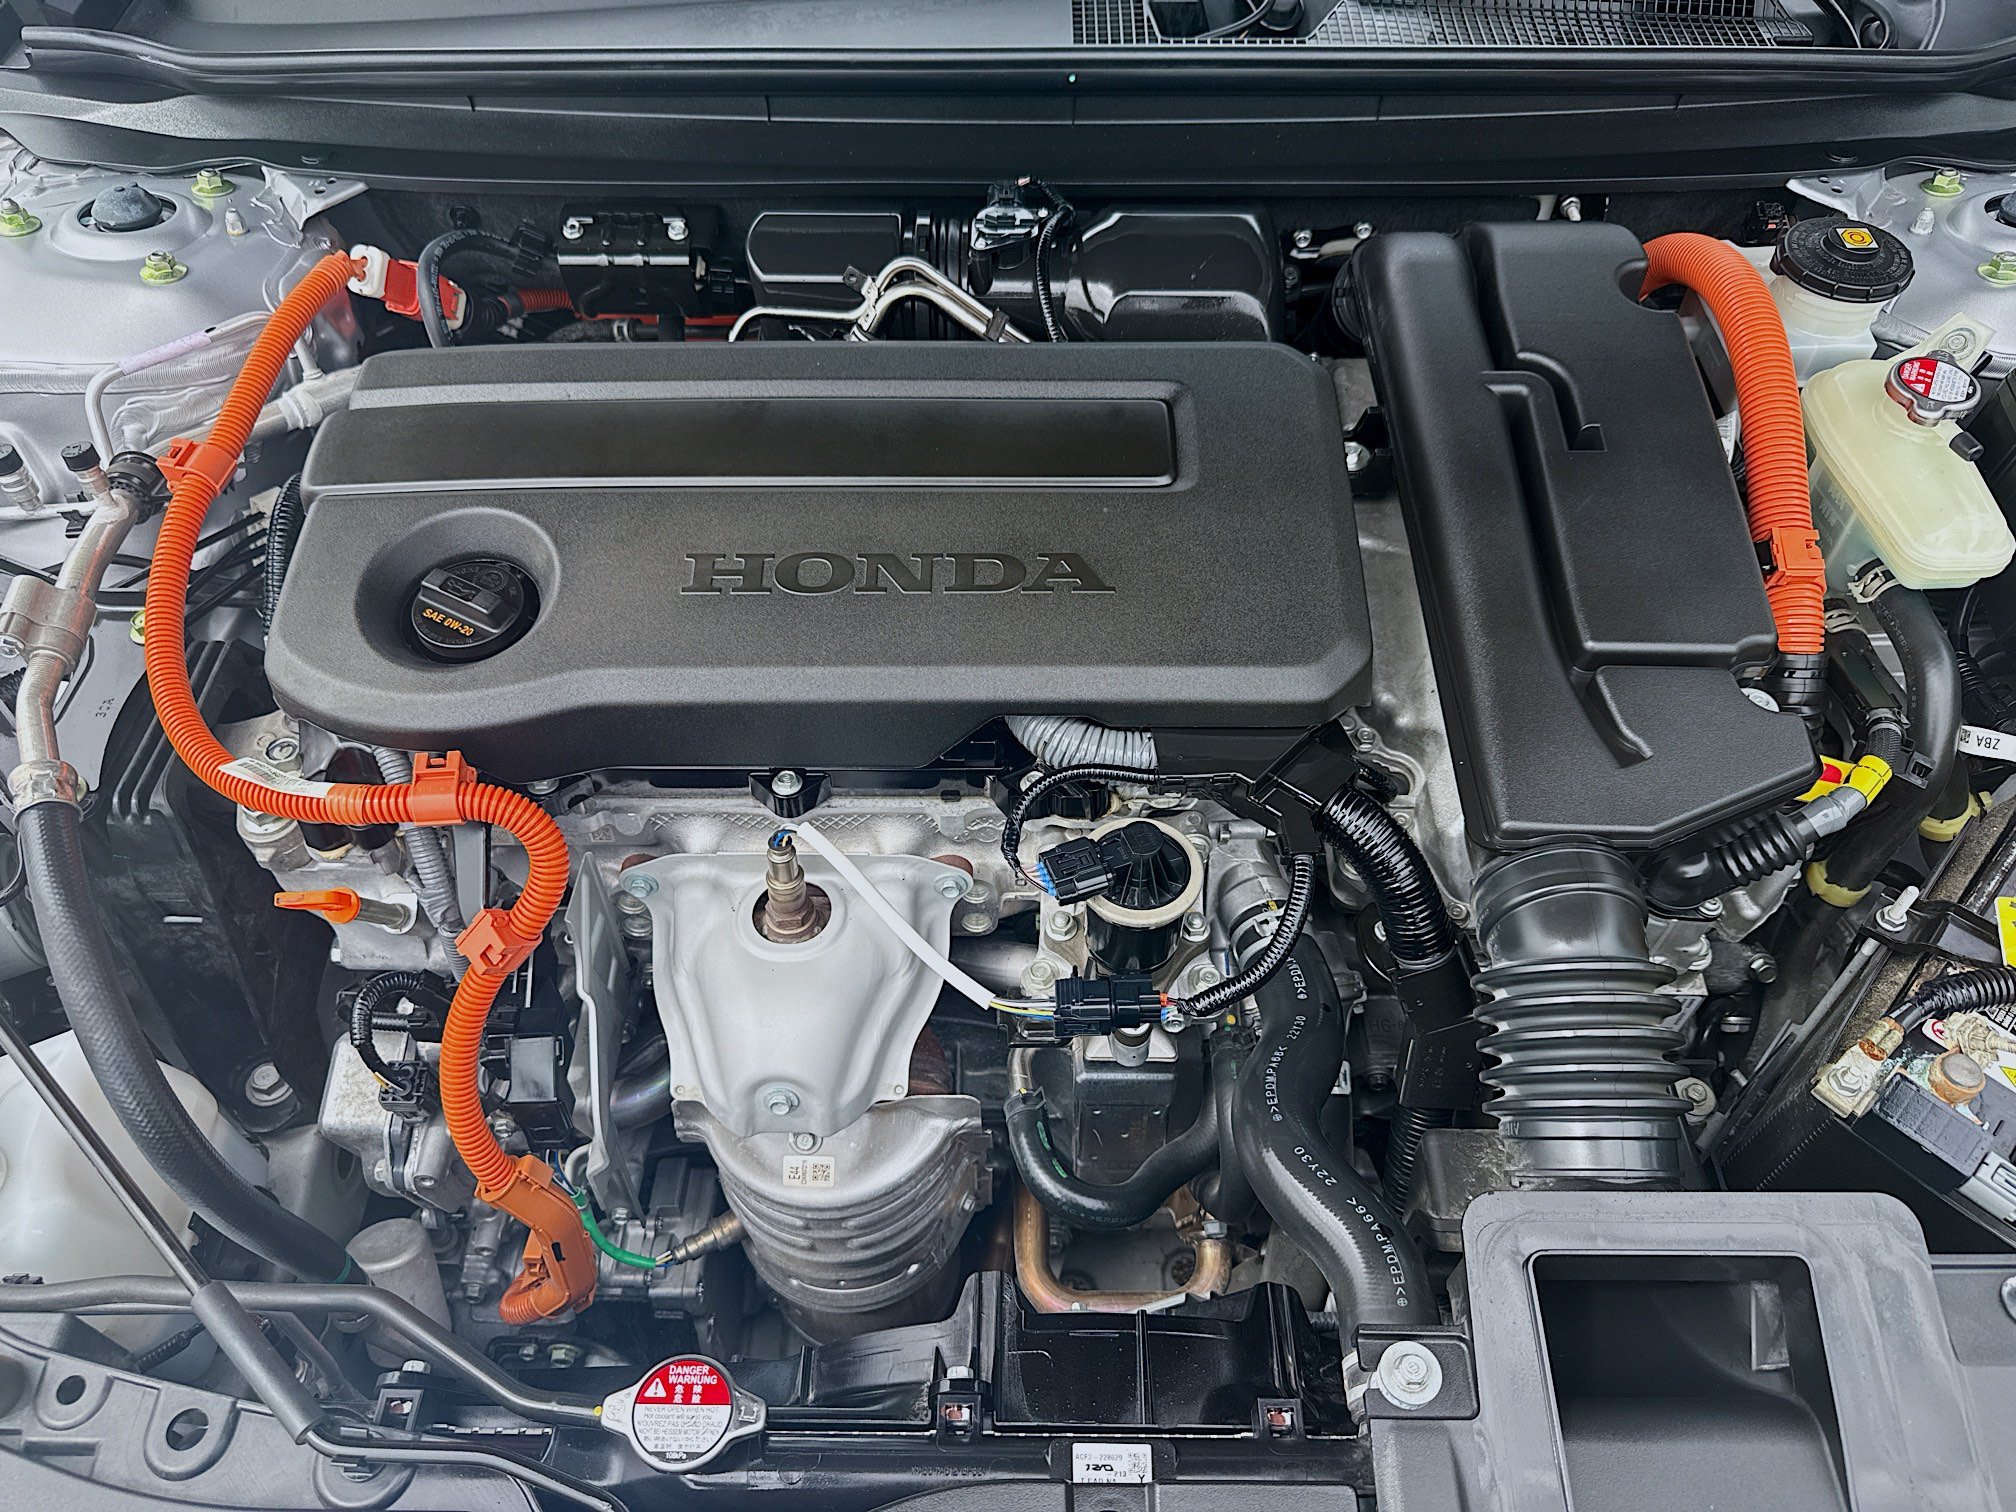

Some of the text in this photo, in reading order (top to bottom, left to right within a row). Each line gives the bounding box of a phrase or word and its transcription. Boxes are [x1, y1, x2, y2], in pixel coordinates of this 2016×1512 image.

[680, 552, 1116, 596] HONDA
[422, 608, 475, 637] SAE 0W-20
[1976, 734, 2001, 751] ZBA
[788, 1166, 801, 1180] E44
[1293, 1146, 1338, 1187] 22Y30
[669, 1365, 710, 1375] DANGER
[668, 1375, 718, 1385] WARNUNG
[1138, 1474, 1146, 1484] Y
